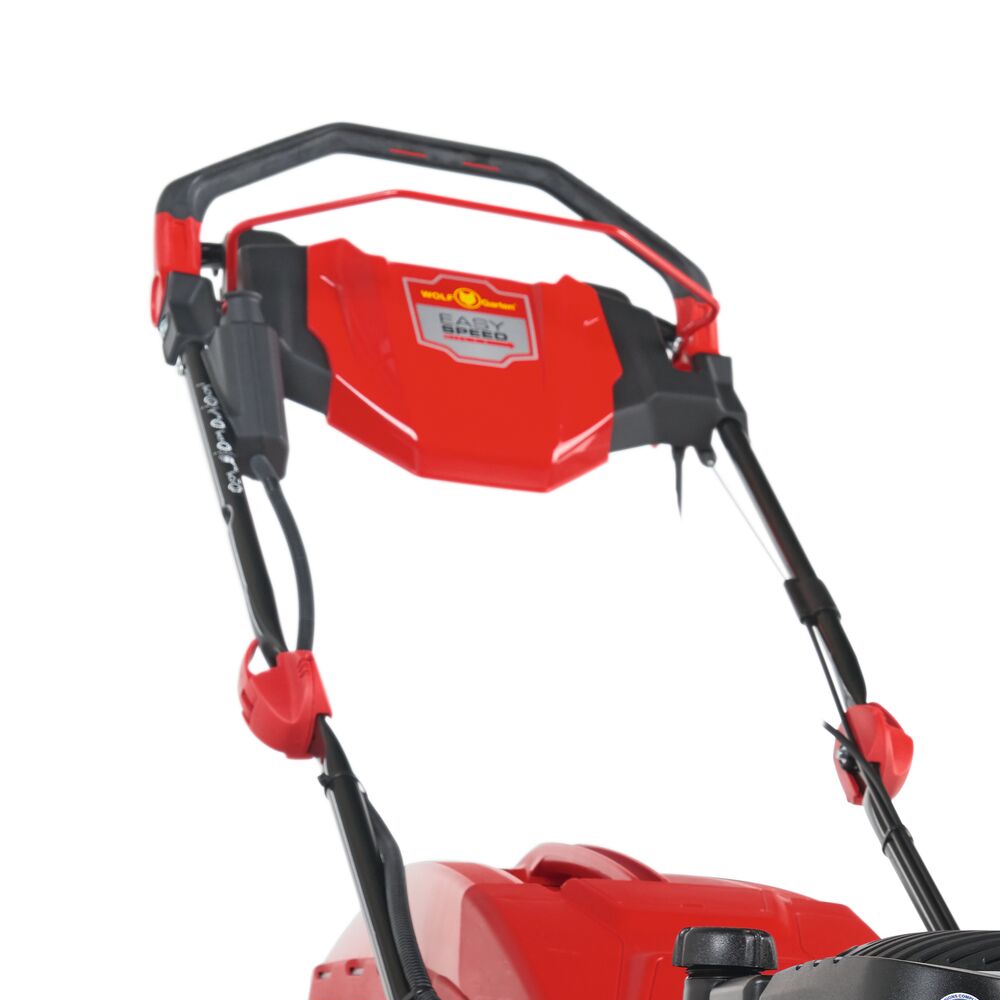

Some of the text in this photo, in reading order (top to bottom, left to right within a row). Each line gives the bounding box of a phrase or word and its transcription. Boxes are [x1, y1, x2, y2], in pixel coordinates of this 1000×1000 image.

[420, 289, 453, 302] WOLF
[439, 312, 504, 331] EASY
[442, 325, 508, 341] SPEED
